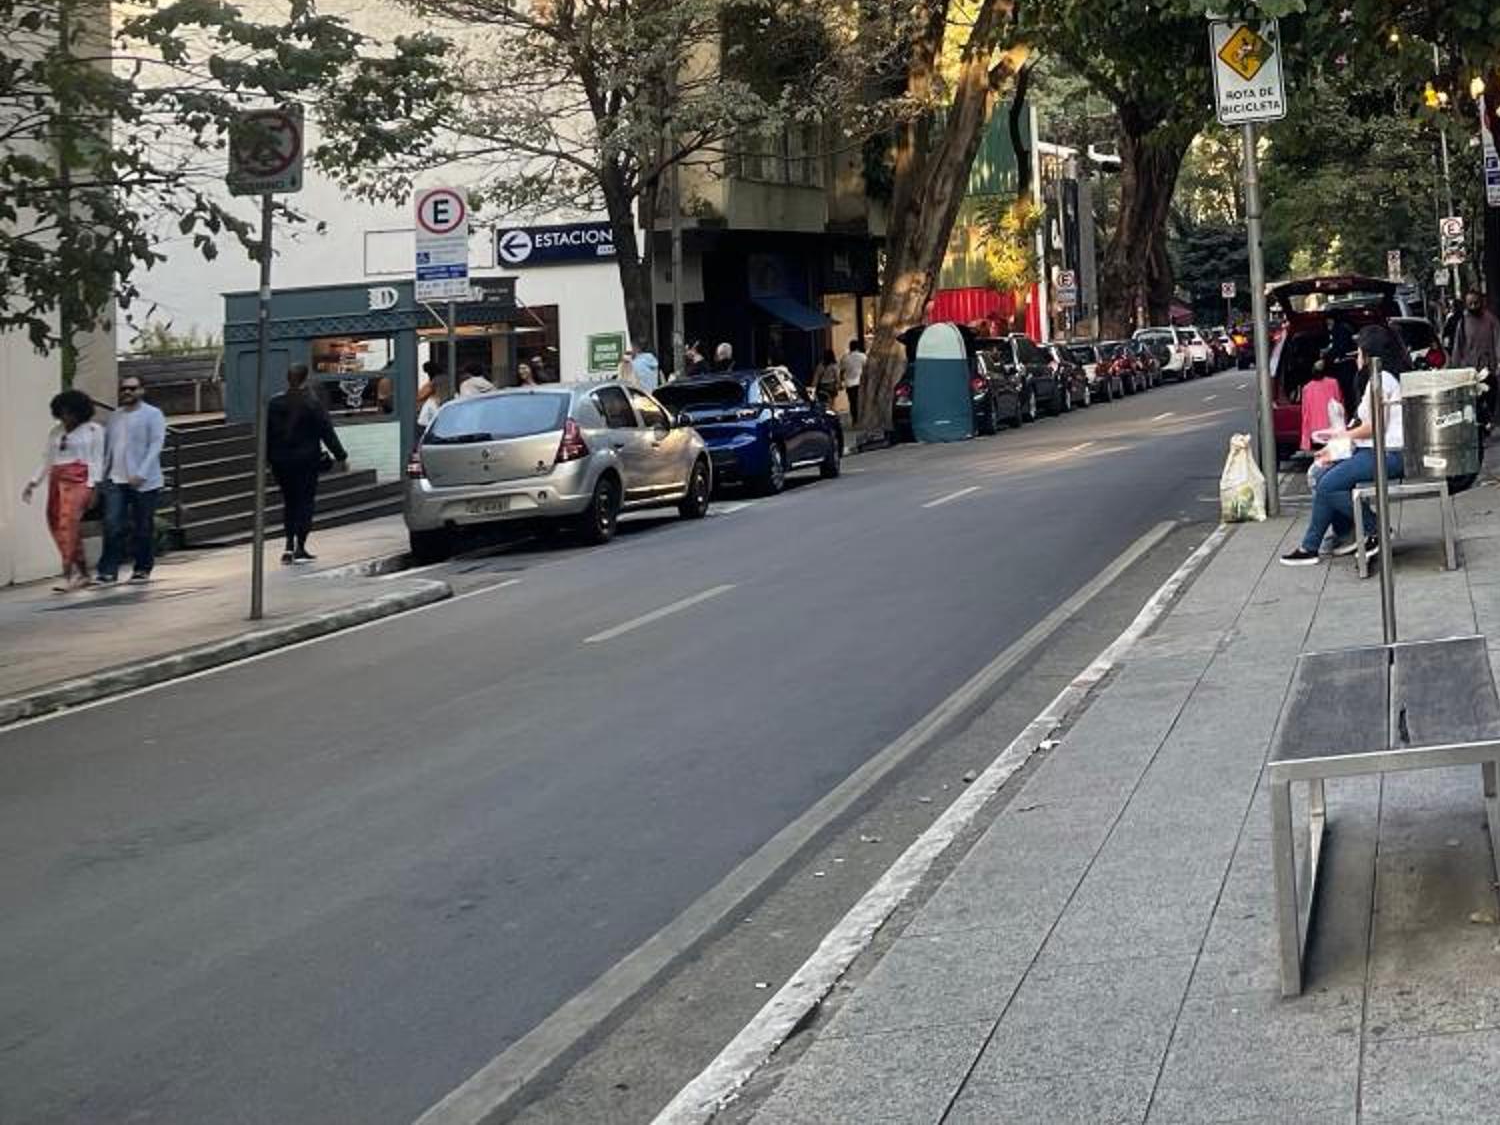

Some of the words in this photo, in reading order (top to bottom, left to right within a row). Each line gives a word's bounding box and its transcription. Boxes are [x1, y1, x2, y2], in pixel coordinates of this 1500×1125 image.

[1225, 88, 1256, 100] ROTA
[1260, 86, 1275, 98] DE
[1221, 101, 1281, 115] BICICLETA
[433, 198, 449, 225] E
